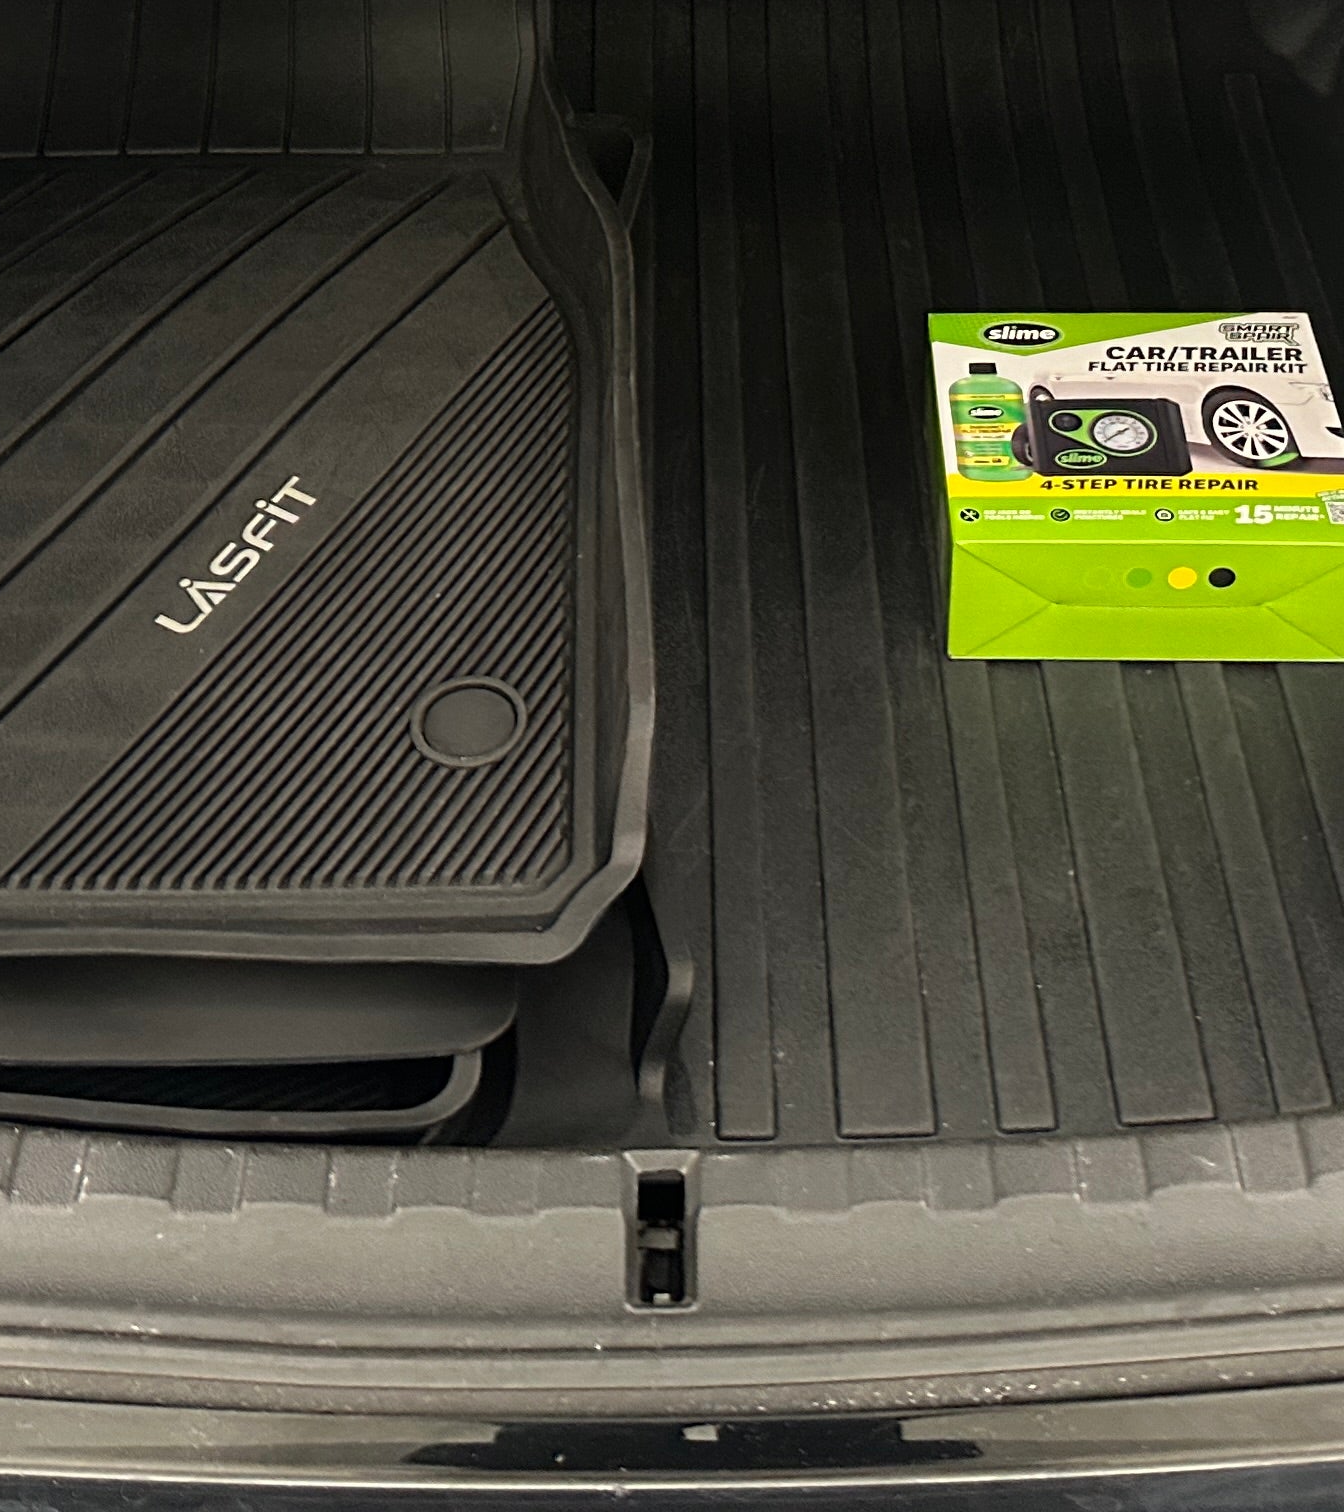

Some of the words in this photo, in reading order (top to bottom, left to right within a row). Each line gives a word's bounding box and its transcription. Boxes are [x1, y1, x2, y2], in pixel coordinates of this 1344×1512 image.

[988, 325, 1056, 340] slime
[1106, 346, 1303, 361] CAR/TRAILER
[1088, 361, 1138, 372] FLAT
[1143, 362, 1189, 372] TIRE
[1194, 362, 1268, 373] REPAIR
[1273, 363, 1308, 374] KIT
[1060, 452, 1103, 463] slime
[1041, 479, 1117, 490] 4-STEP
[1123, 479, 1172, 490] TIRE
[1178, 479, 1259, 491] REPAIR
[1234, 504, 1274, 525] 15
